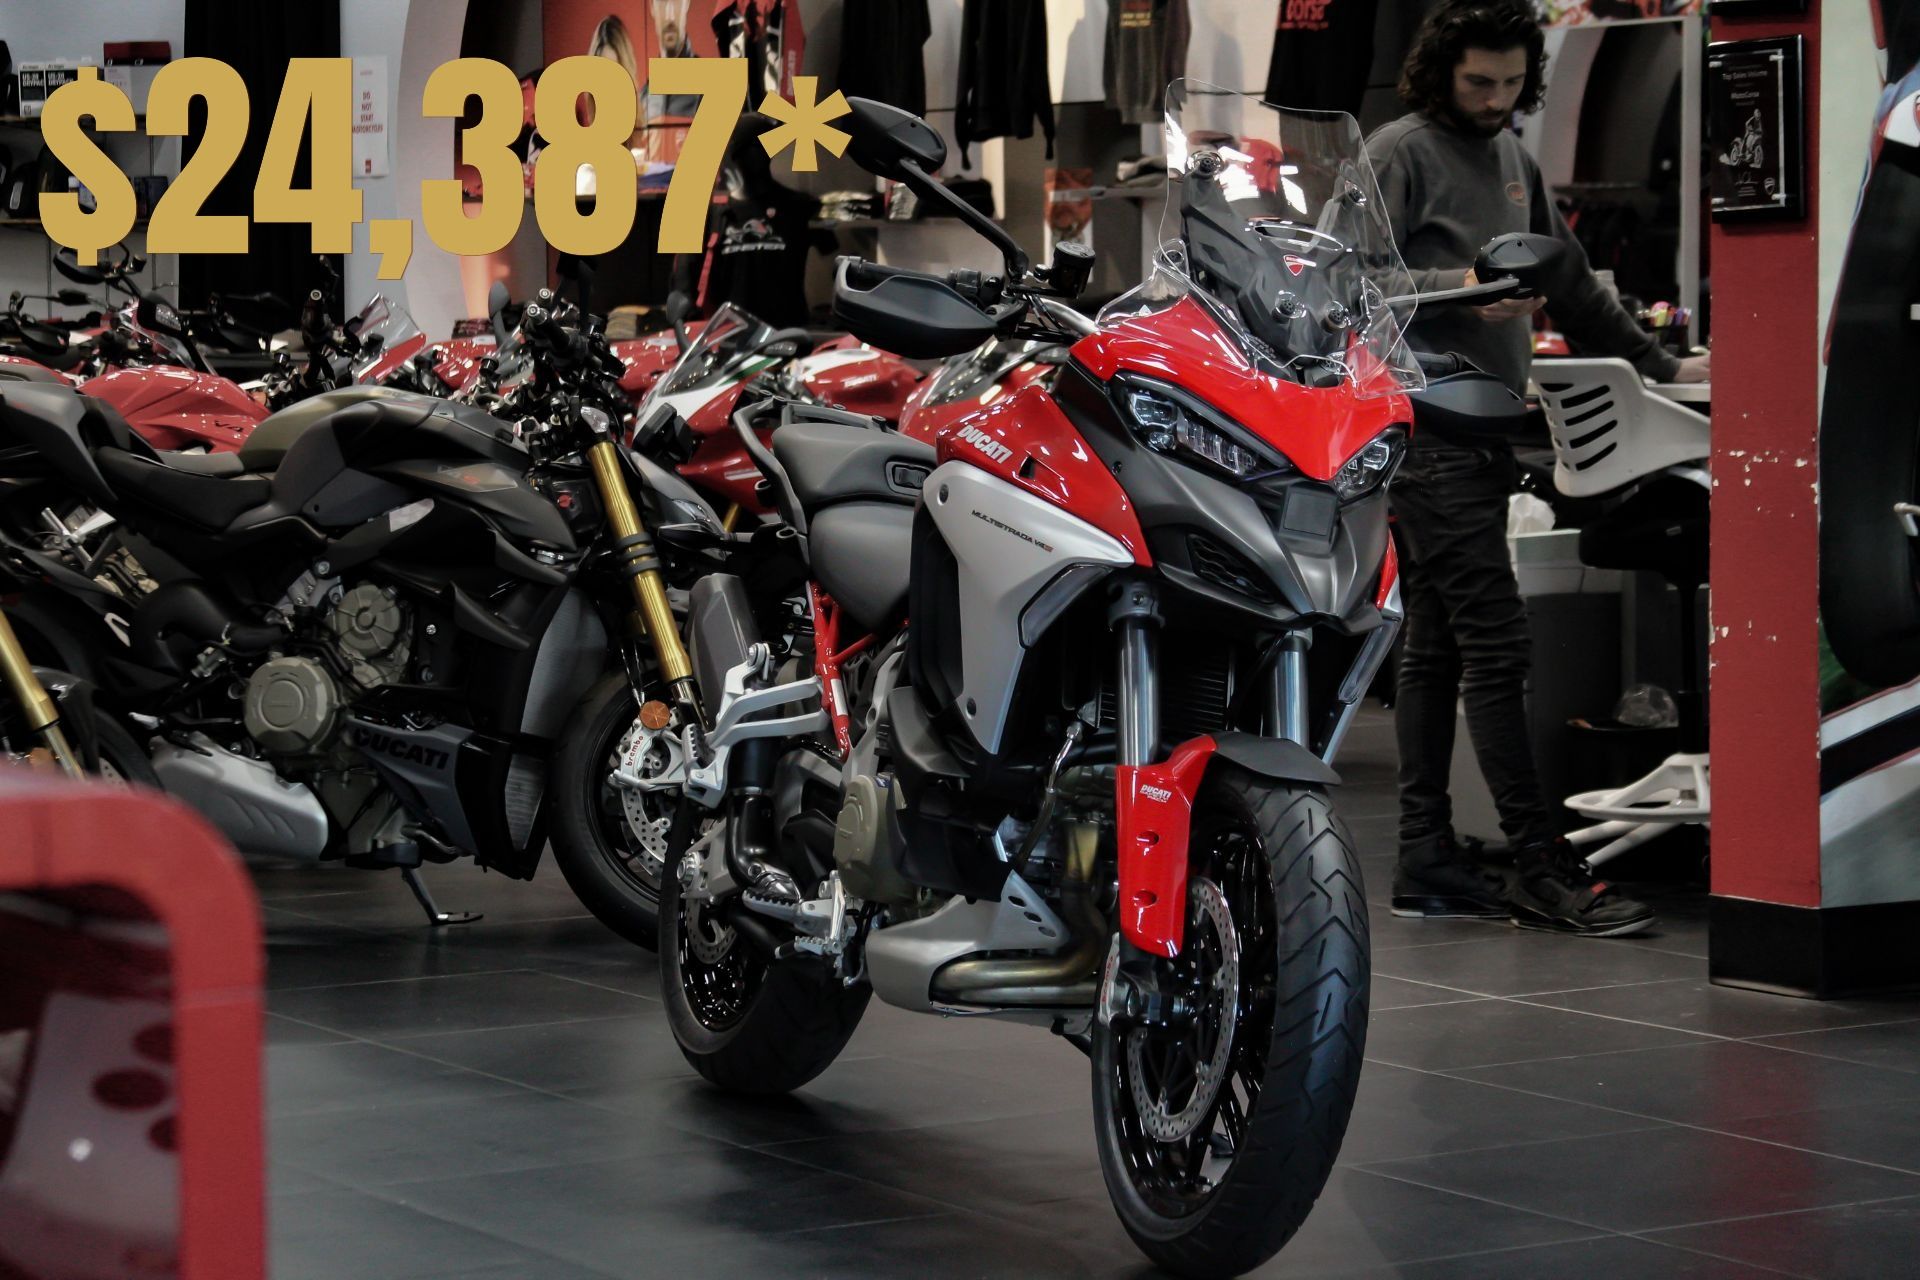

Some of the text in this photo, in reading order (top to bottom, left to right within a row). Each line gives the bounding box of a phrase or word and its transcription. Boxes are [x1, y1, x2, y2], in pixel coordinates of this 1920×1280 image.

[361, 103, 372, 111] NOT
[362, 91, 371, 100] DO
[956, 424, 1014, 464] DUCATI
[971, 509, 1033, 544] MULTISTRADA
[352, 727, 450, 771] DUCATI
[624, 735, 644, 767] brembo
[1140, 784, 1172, 799] DUCATI
